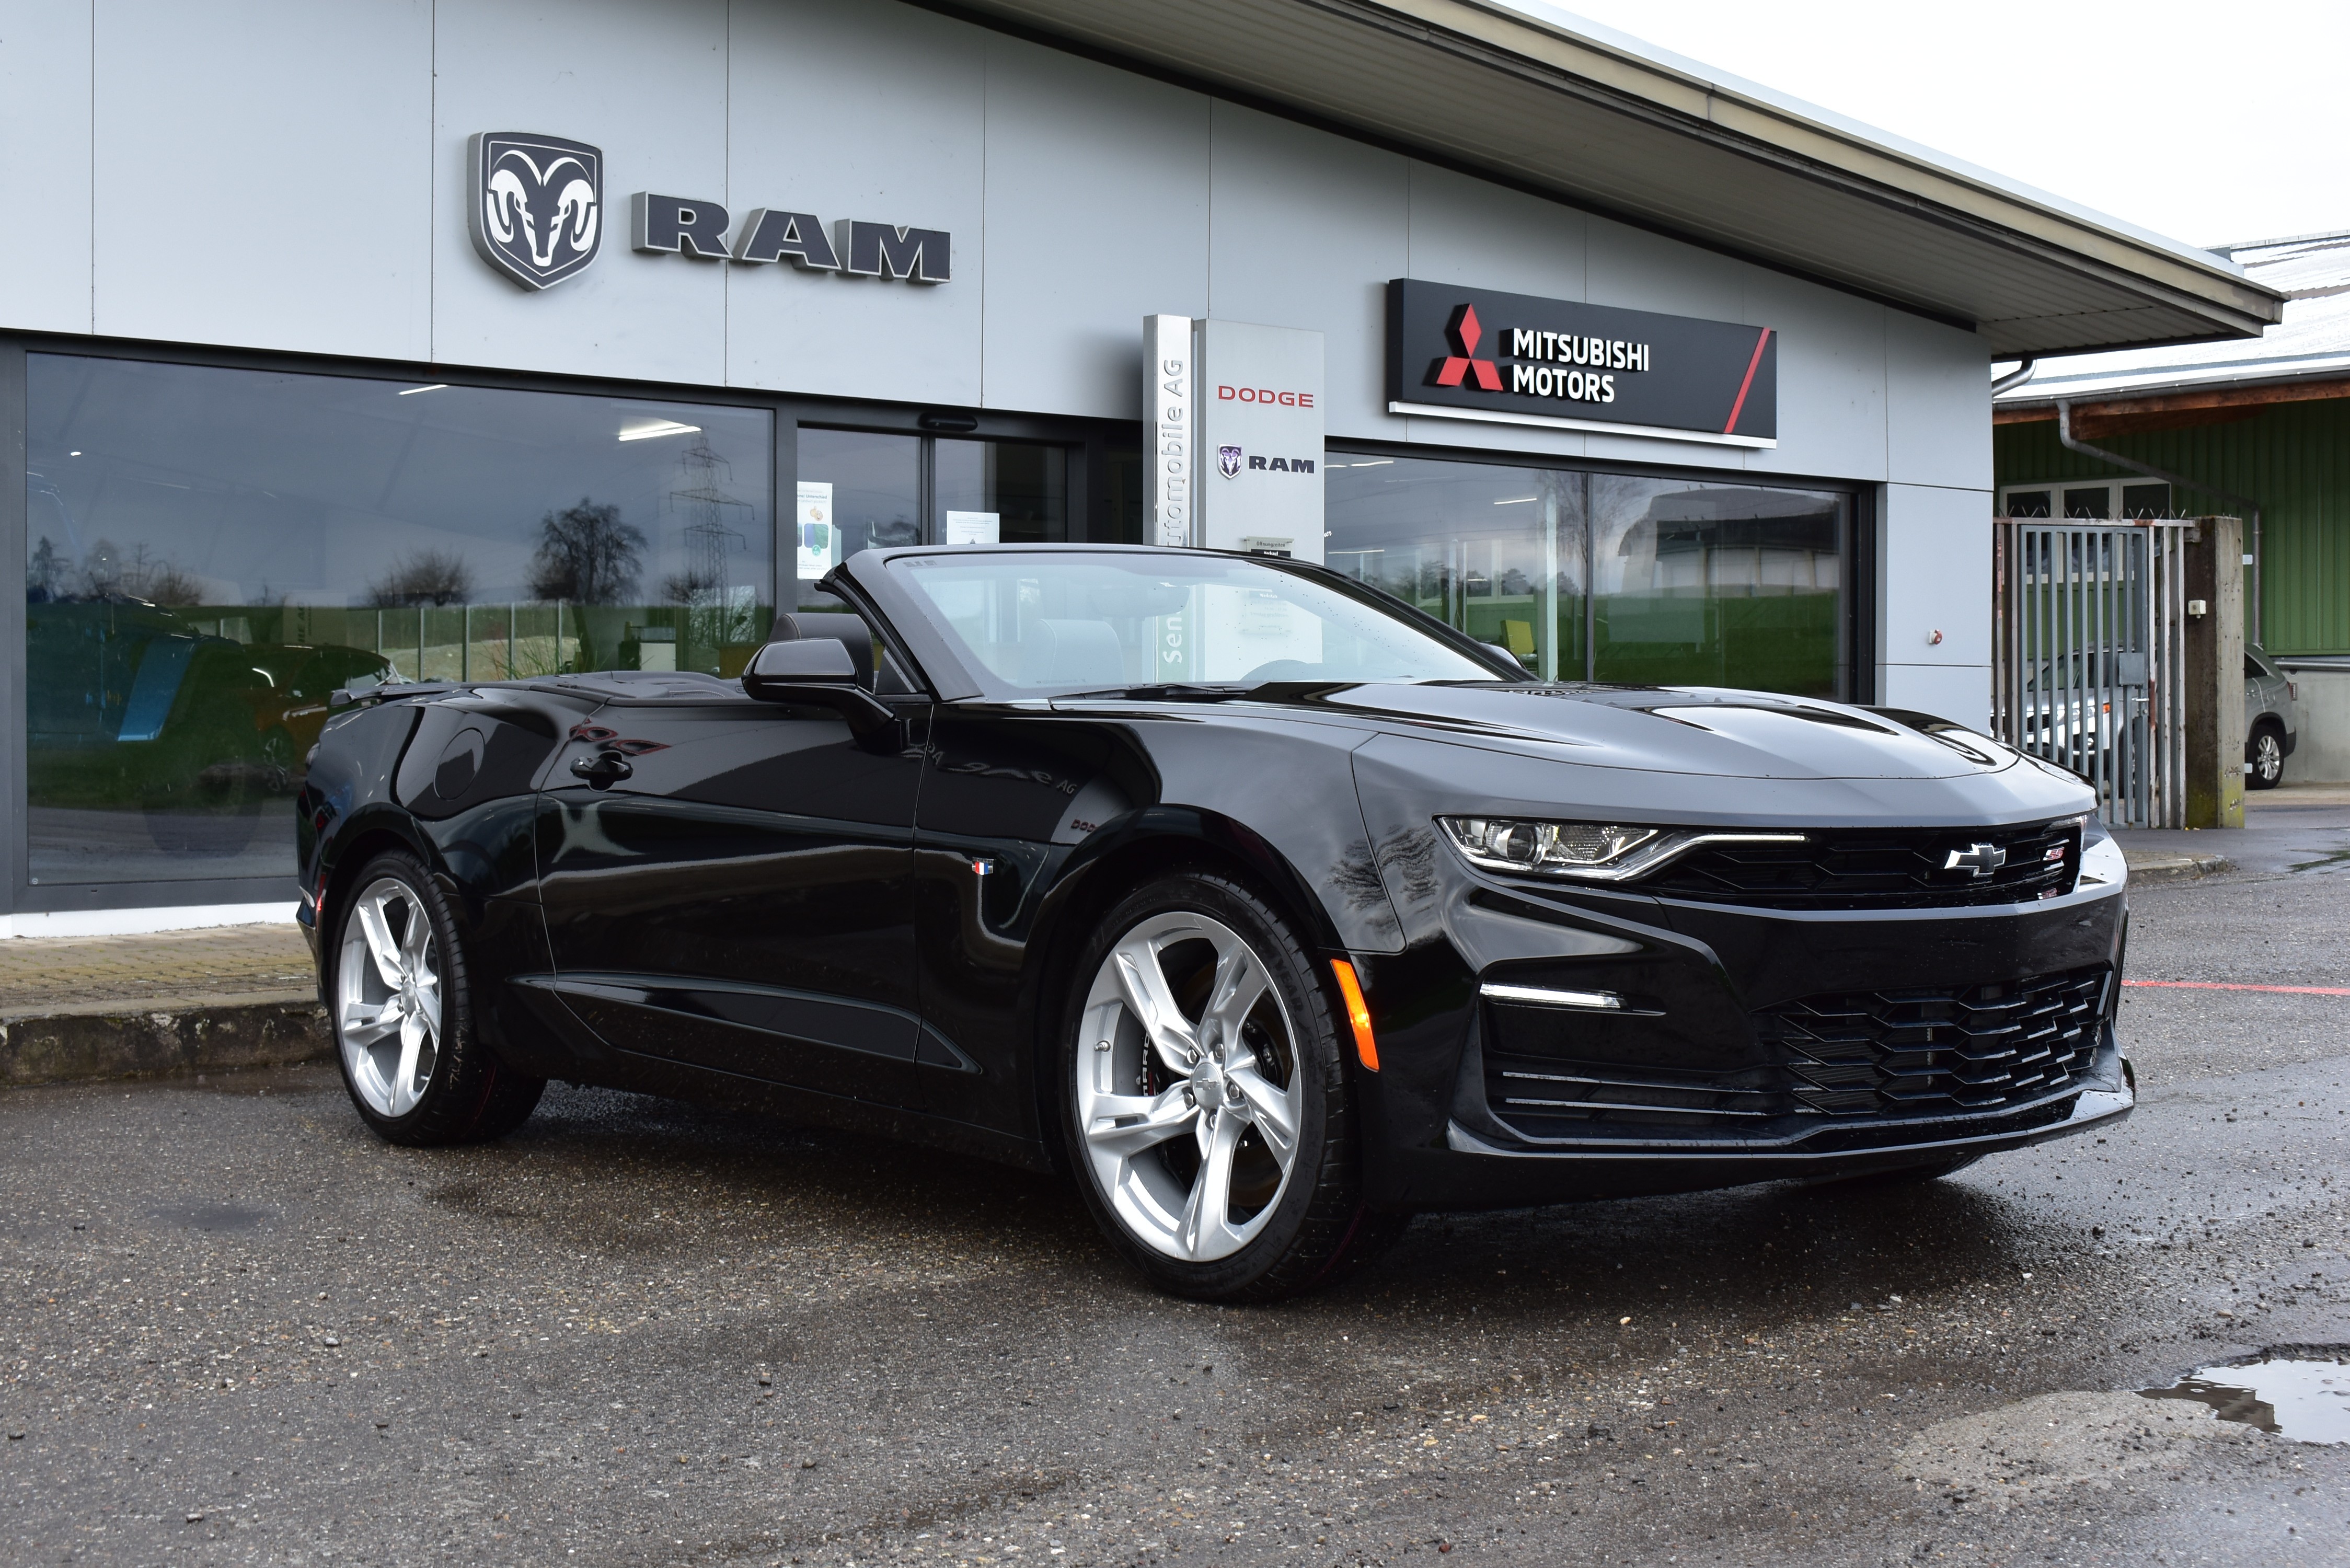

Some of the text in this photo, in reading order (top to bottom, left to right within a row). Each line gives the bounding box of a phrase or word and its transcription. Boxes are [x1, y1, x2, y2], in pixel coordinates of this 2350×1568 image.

[632, 191, 951, 285] RAM
[1513, 328, 1649, 372] MITSUBISHI
[1218, 385, 1314, 408] DODGE
[1513, 364, 1615, 403] MOTORS
[1249, 455, 1314, 474] RAM
[1161, 360, 1183, 663] Sen utomobile AG
[2043, 847, 2065, 861] SS
